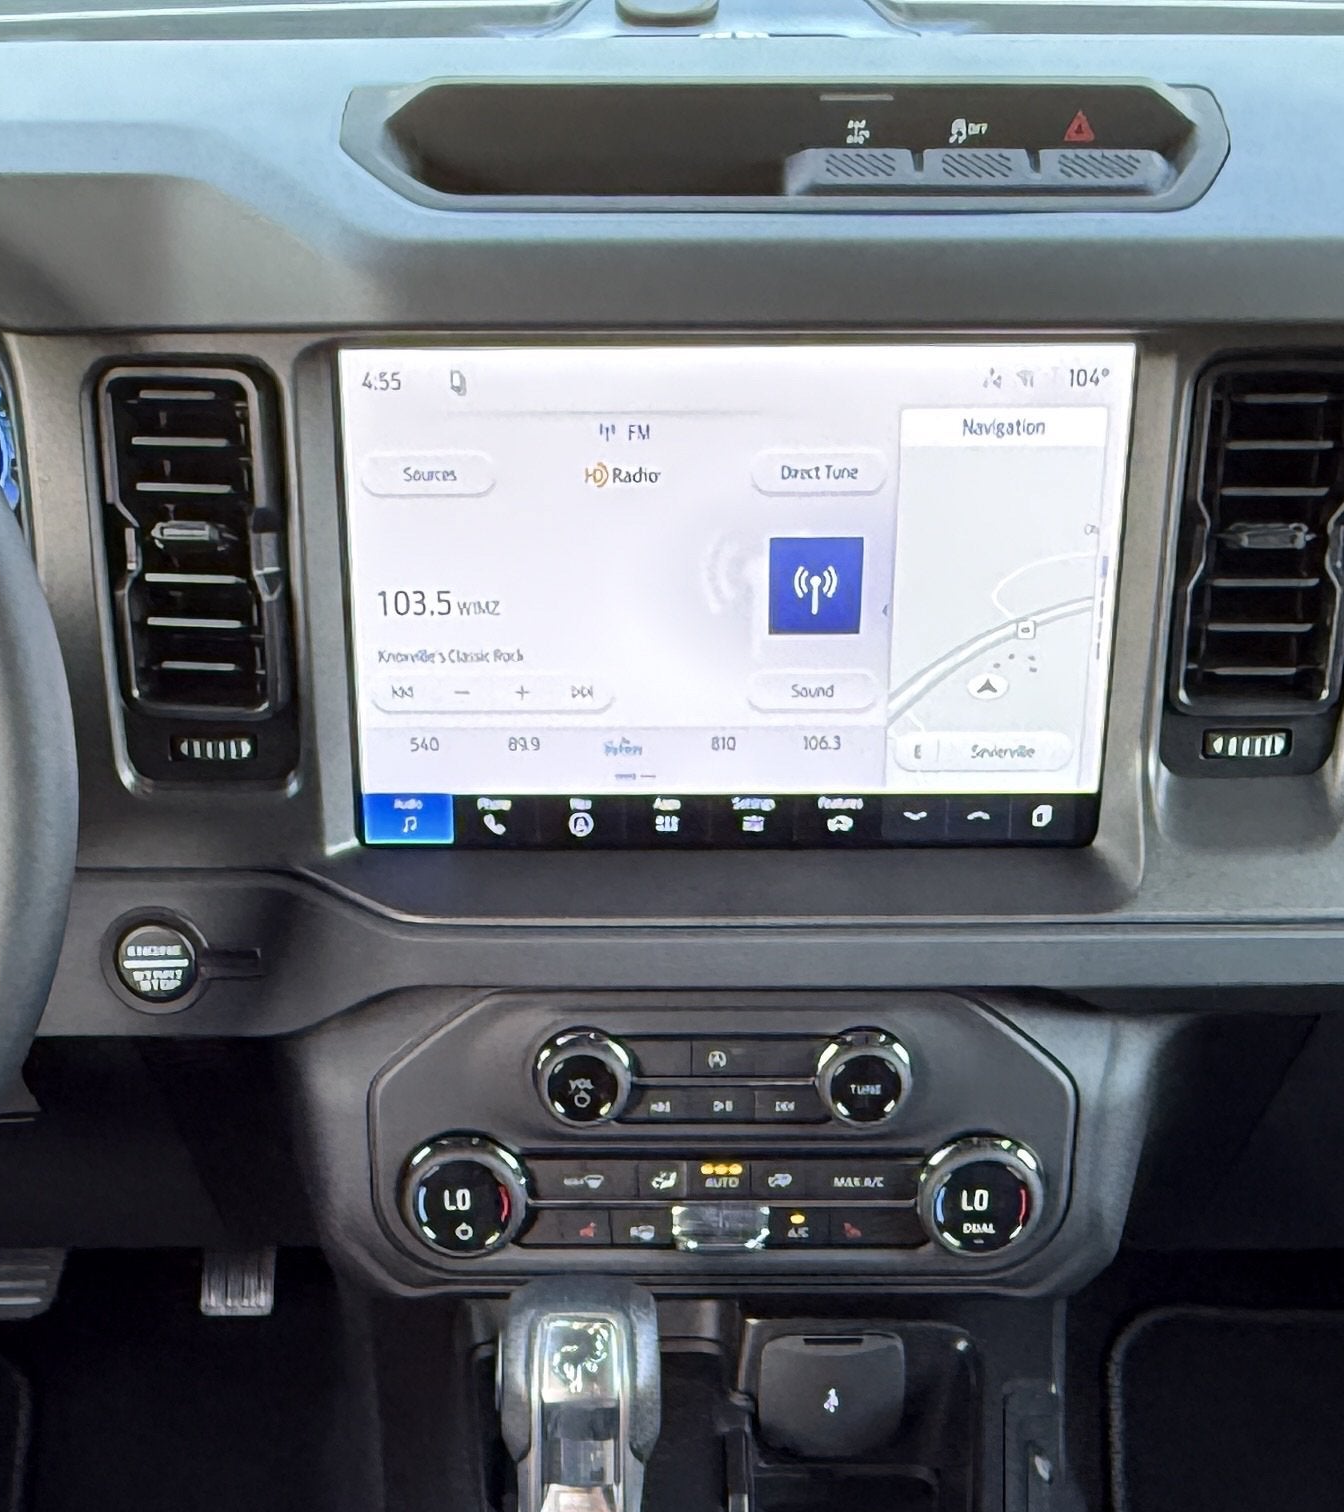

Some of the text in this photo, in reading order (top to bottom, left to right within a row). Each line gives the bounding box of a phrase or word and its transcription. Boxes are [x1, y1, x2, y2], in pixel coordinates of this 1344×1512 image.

[361, 371, 402, 391] 4:55
[1069, 367, 1110, 388] 104°
[628, 424, 650, 441] FM
[962, 418, 1046, 439] Navigation
[612, 466, 661, 483] Radio
[377, 590, 452, 616] 103.5
[791, 683, 835, 699] Sound
[409, 736, 440, 752] 540
[507, 736, 540, 752] 89.9
[711, 736, 736, 751] 810
[803, 735, 842, 751] 106.3
[705, 1177, 740, 1188] AUTO
[443, 1188, 471, 1211] LO
[961, 1189, 990, 1212] LO
